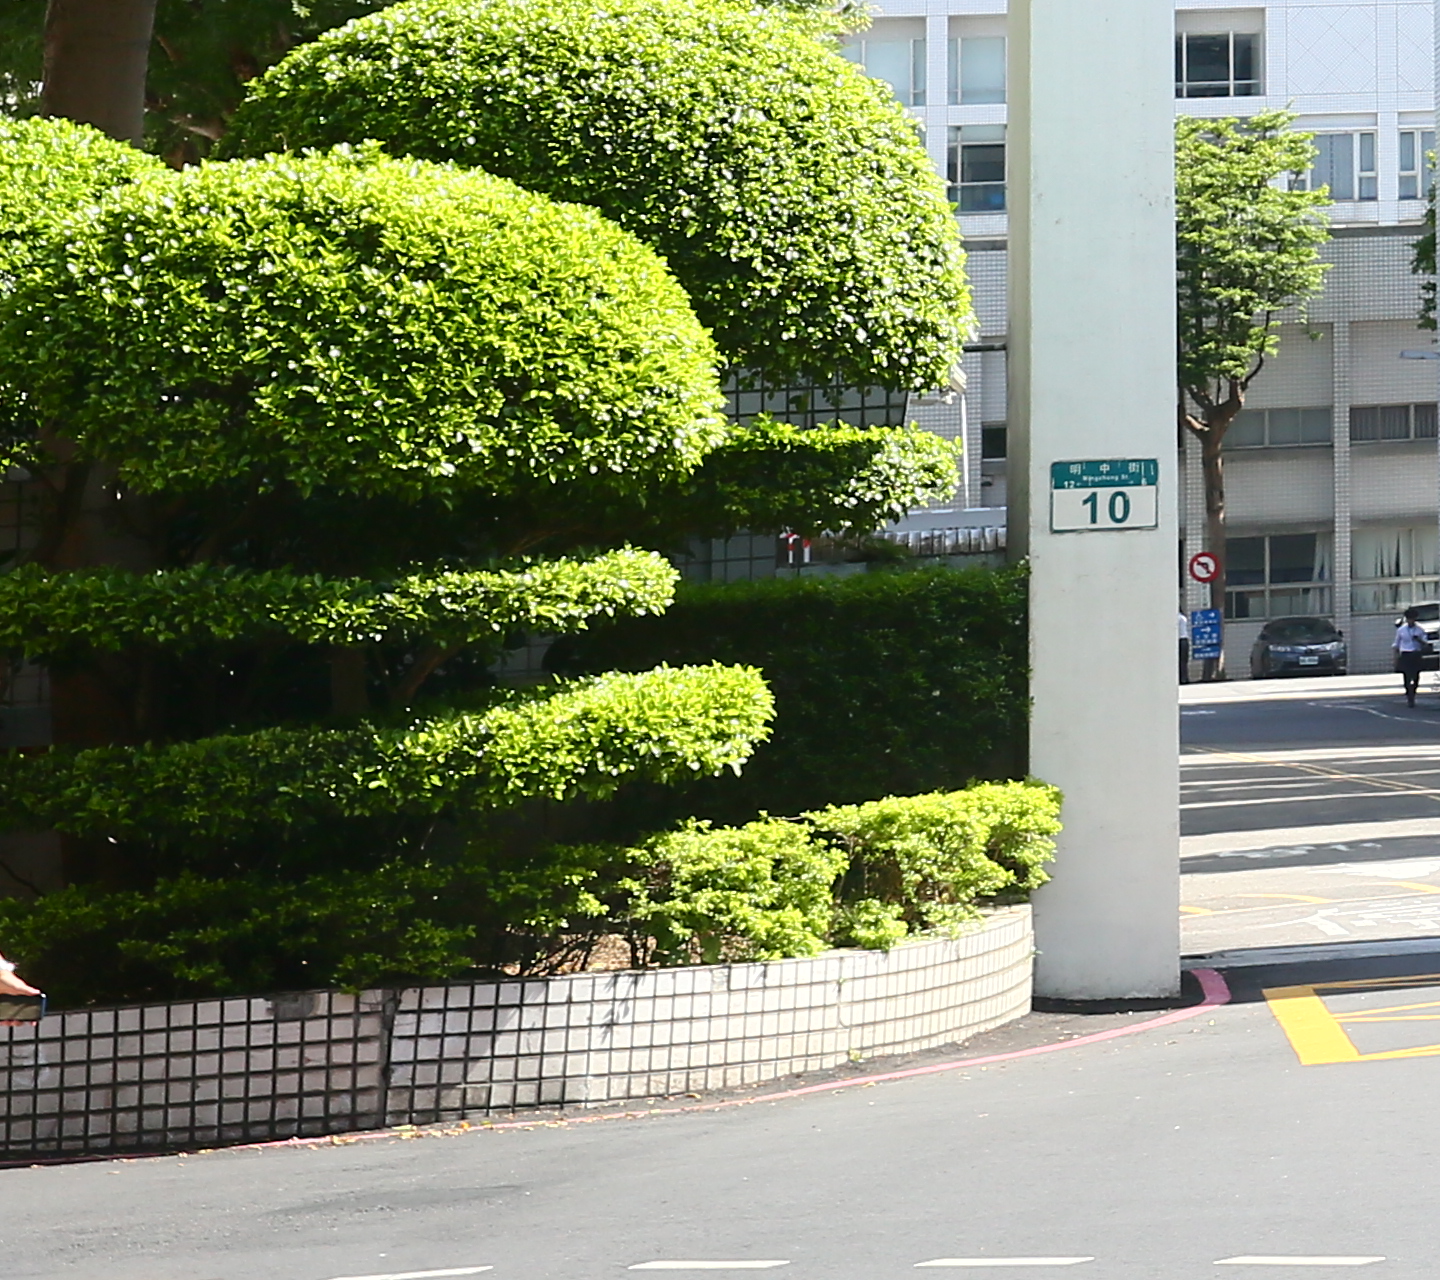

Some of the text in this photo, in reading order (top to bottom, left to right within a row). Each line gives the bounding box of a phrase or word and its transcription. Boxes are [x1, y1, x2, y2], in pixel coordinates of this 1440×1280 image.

[1069, 462, 1140, 475] 明中街
[1082, 491, 1131, 524] 10
